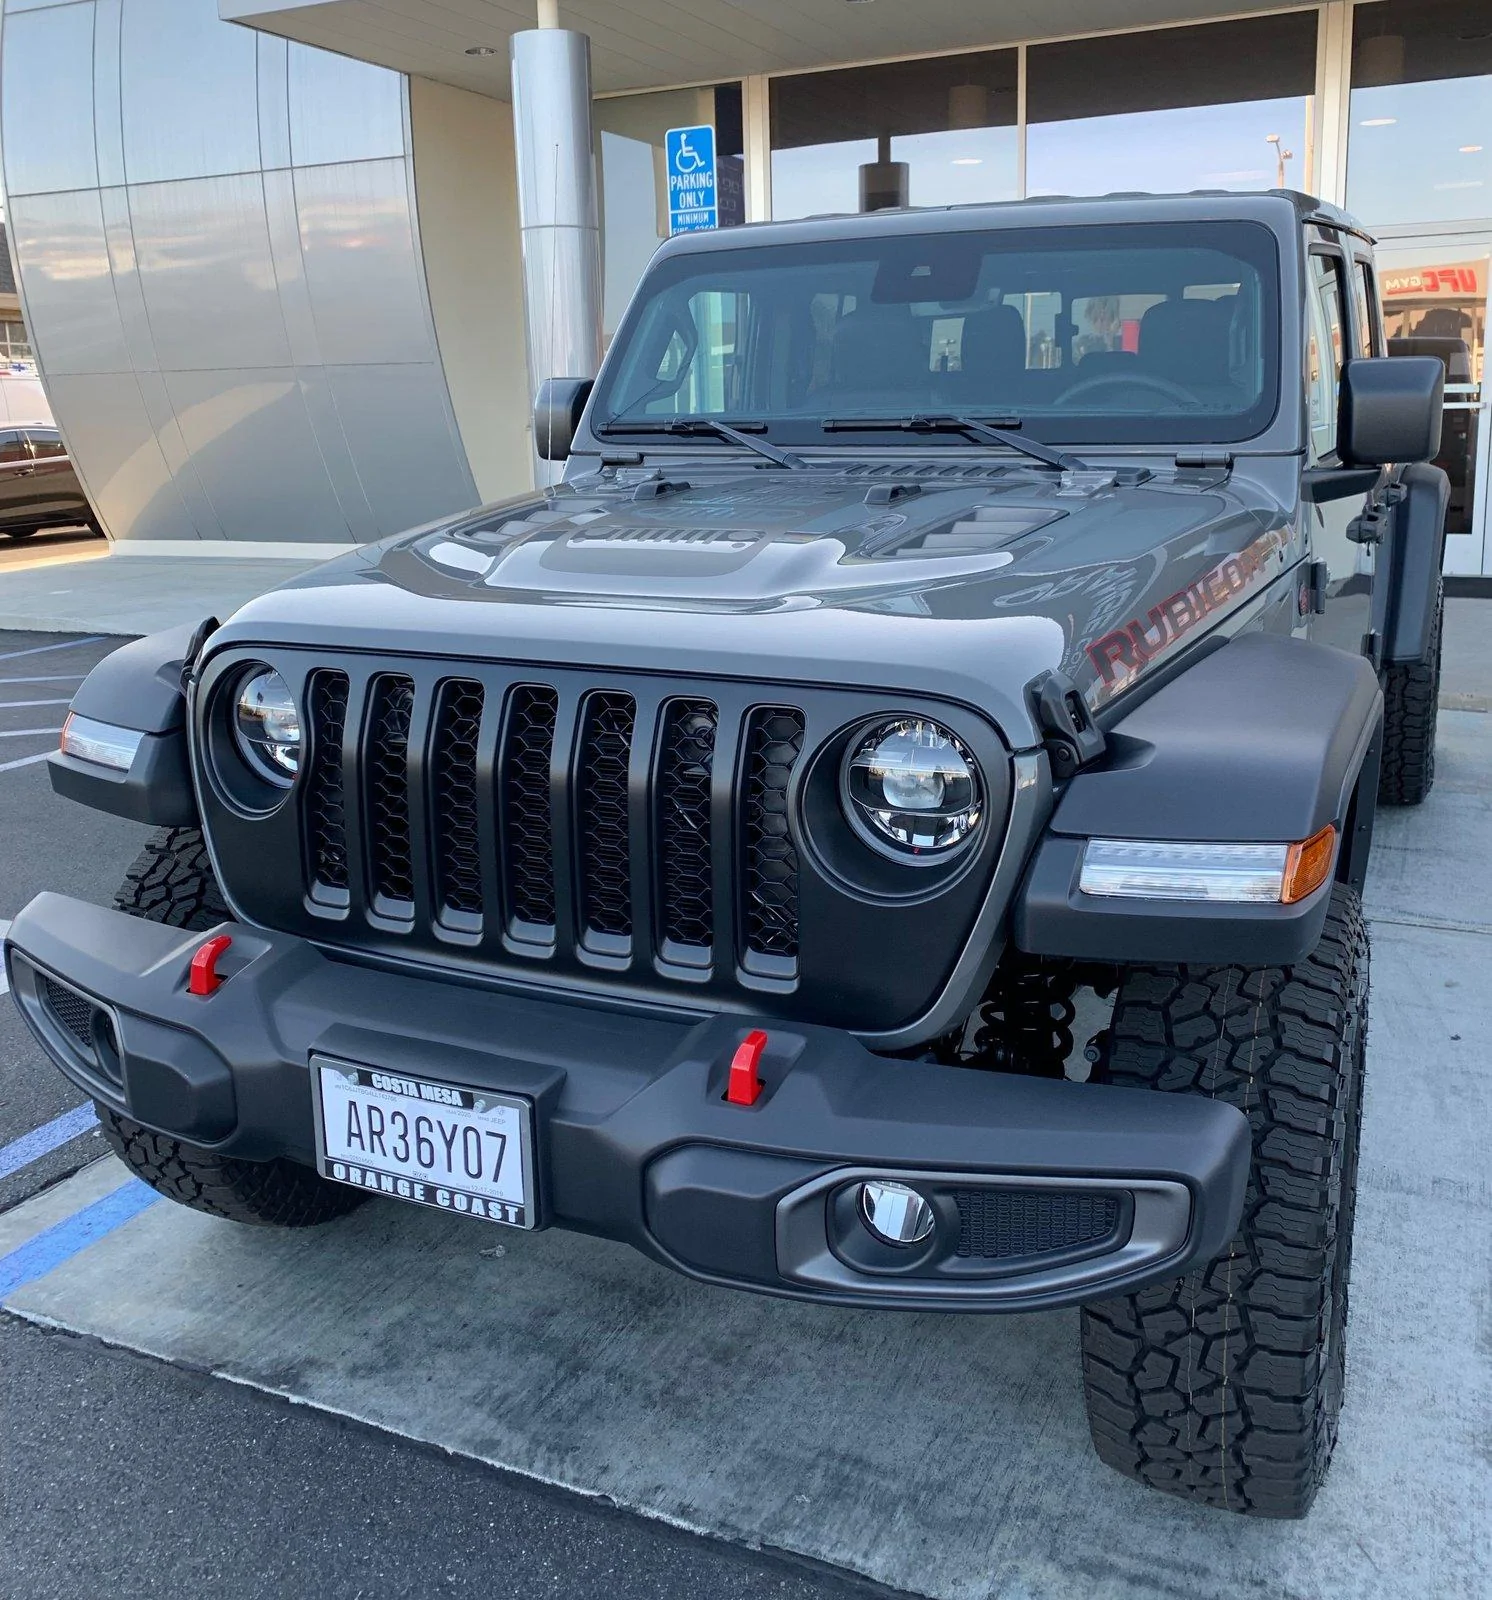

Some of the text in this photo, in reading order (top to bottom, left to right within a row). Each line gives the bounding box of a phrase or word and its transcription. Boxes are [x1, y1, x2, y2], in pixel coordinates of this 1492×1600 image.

[670, 171, 713, 191] PARKING
[679, 190, 705, 209] ONLY
[677, 211, 709, 226] MINIMUM
[1085, 541, 1268, 688] RUBICON
[371, 1072, 464, 1107] COSTA MESA
[491, 1117, 506, 1125] JEEP
[347, 1100, 507, 1184] AR36Y07
[332, 1162, 519, 1224] ORANGE COAST
